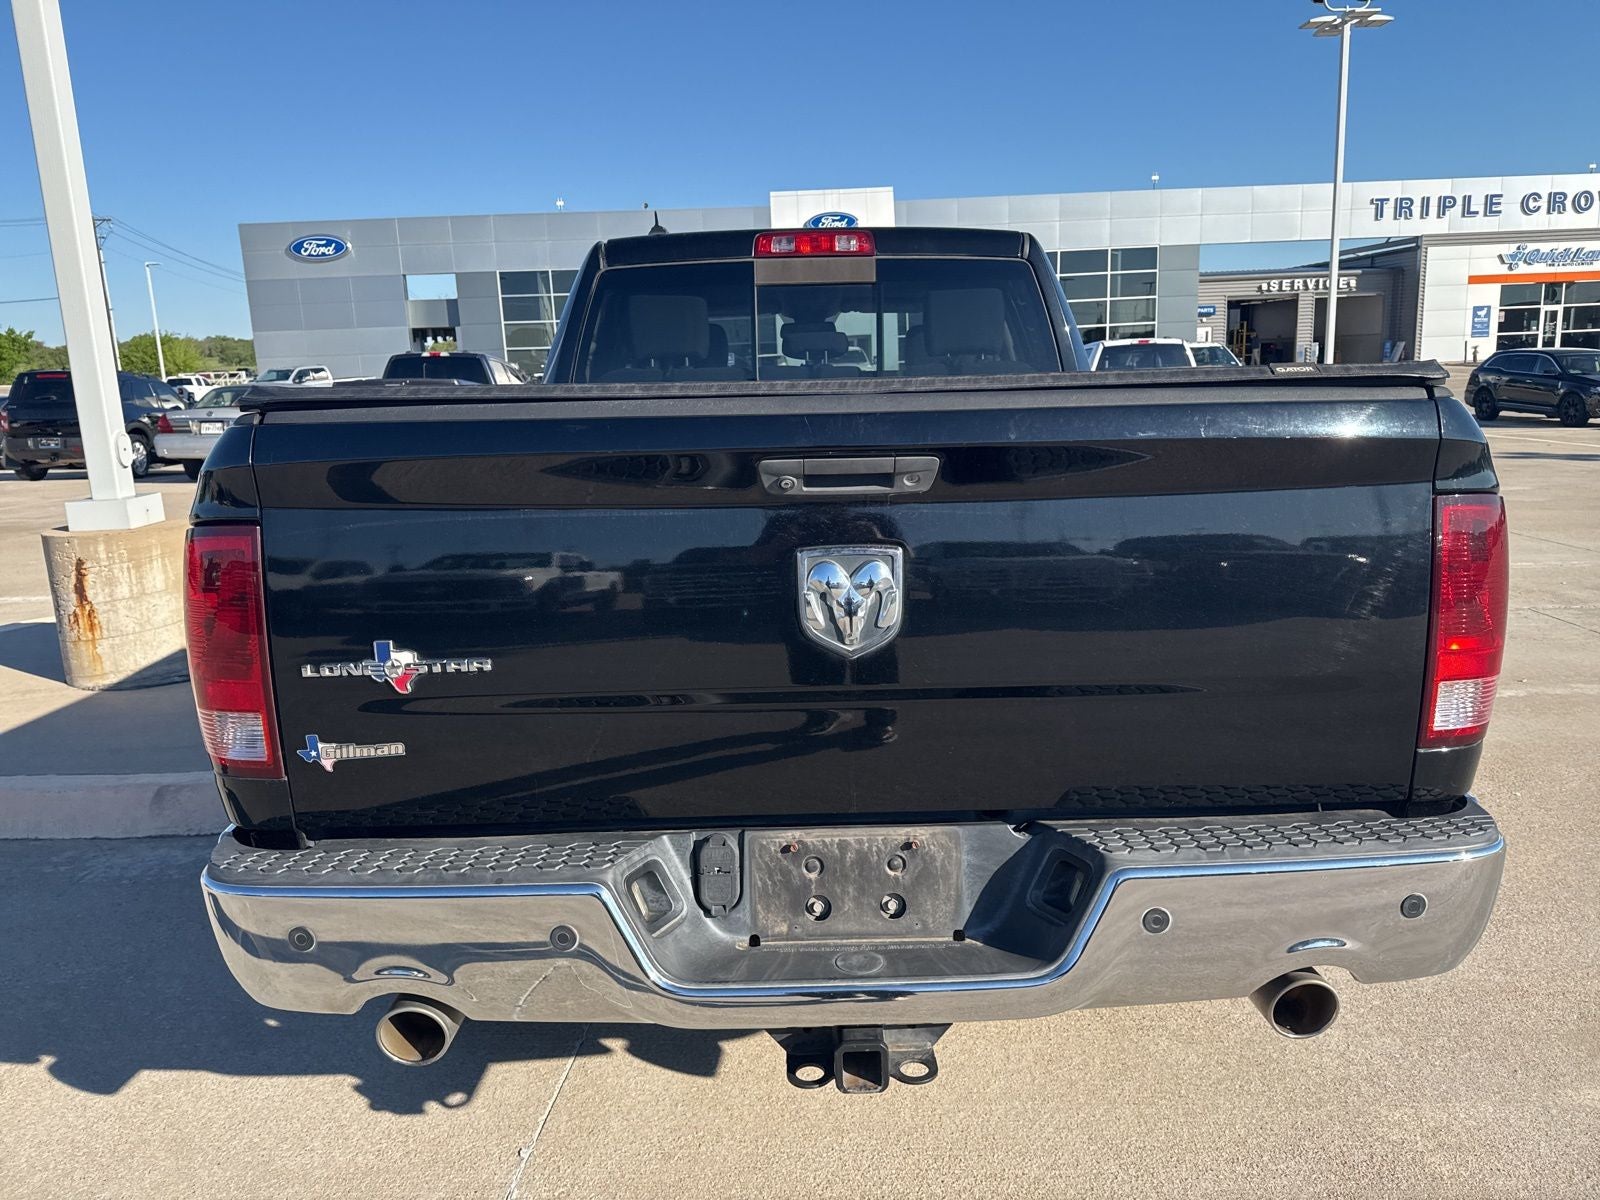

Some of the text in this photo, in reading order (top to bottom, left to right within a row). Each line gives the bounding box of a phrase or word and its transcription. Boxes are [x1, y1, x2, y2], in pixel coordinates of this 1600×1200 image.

[1371, 189, 1600, 221] TRIPLE CRO
[818, 215, 848, 228] Ford
[300, 240, 336, 256] Ford
[1524, 247, 1574, 266] Quick
[301, 658, 492, 678] LONE STAR
[320, 743, 405, 760] Gillman
